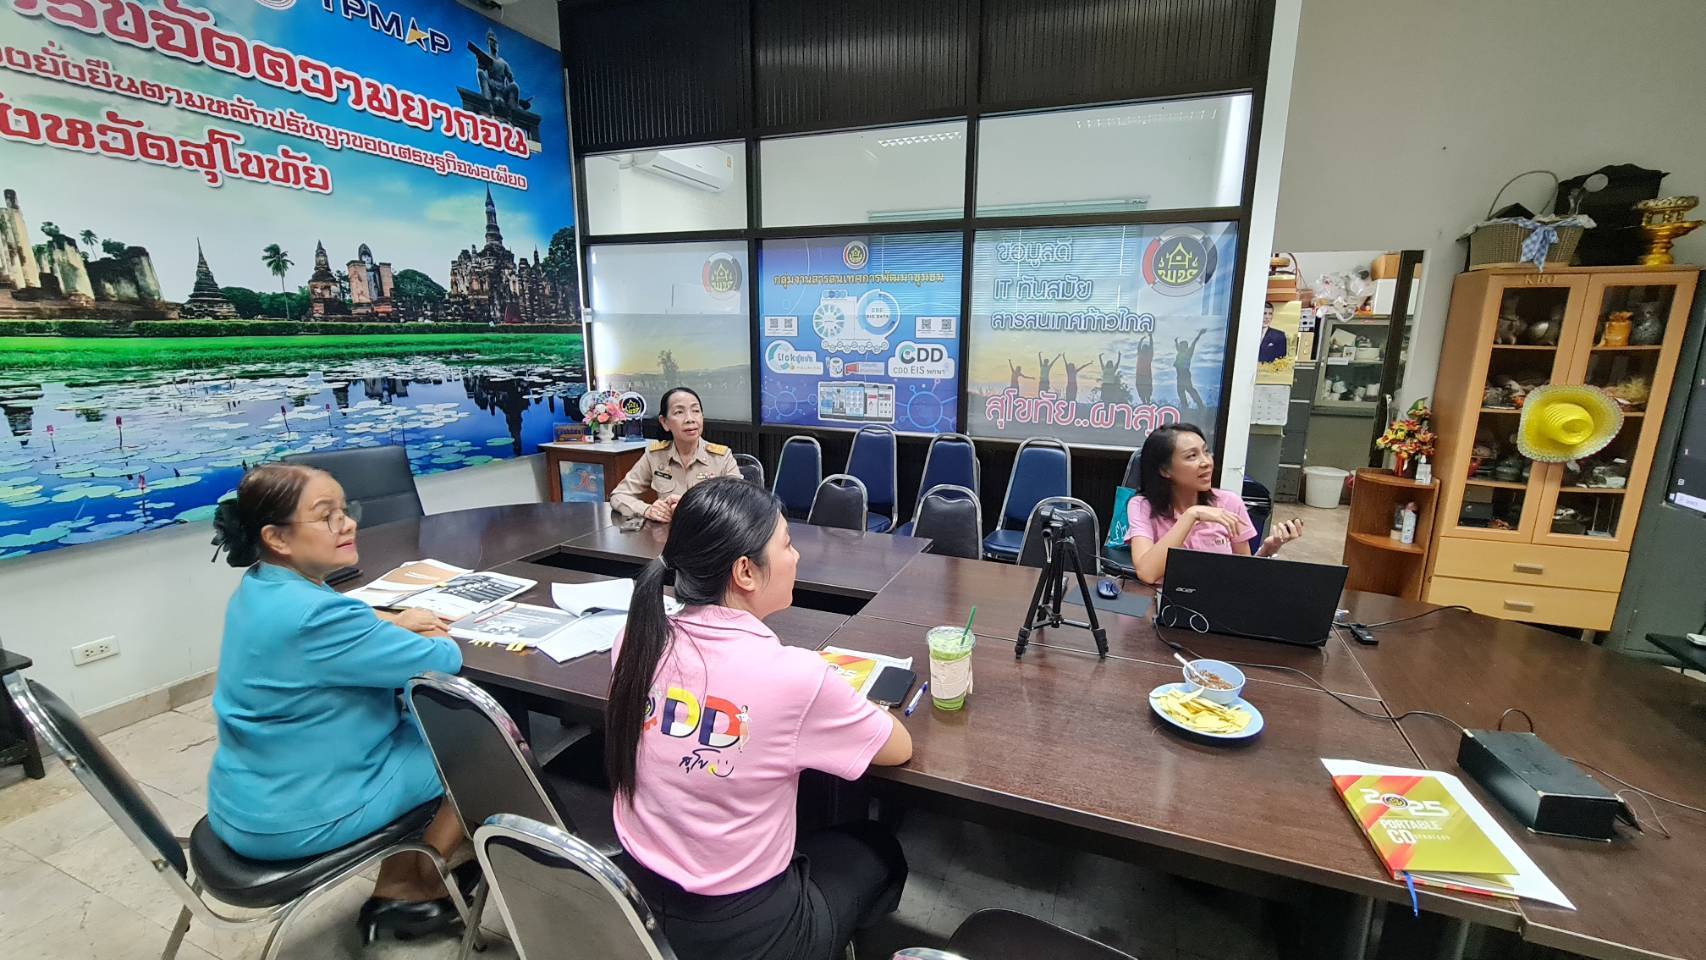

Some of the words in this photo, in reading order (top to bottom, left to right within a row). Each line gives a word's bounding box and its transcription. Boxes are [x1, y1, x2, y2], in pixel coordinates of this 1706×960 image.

[0, 39, 528, 189] งยั่งยืนตามหลักปรัชญาของเศรษฐกิจพอเพียง
[0, 91, 332, 192] งหวัดสุโขทัย
[997, 238, 1073, 267] ข้อมูลดี
[993, 279, 1012, 300] IT
[1017, 275, 1093, 300] ทันสมัย
[992, 307, 1156, 333] สารสนเทศก้าวไกล
[899, 345, 944, 364] CDD
[910, 365, 926, 375] EIS
[986, 387, 1181, 436] สุโขทัย..ผาสุก
[1359, 788, 1450, 817] 2025
[1379, 818, 1443, 831] PORTABLE
